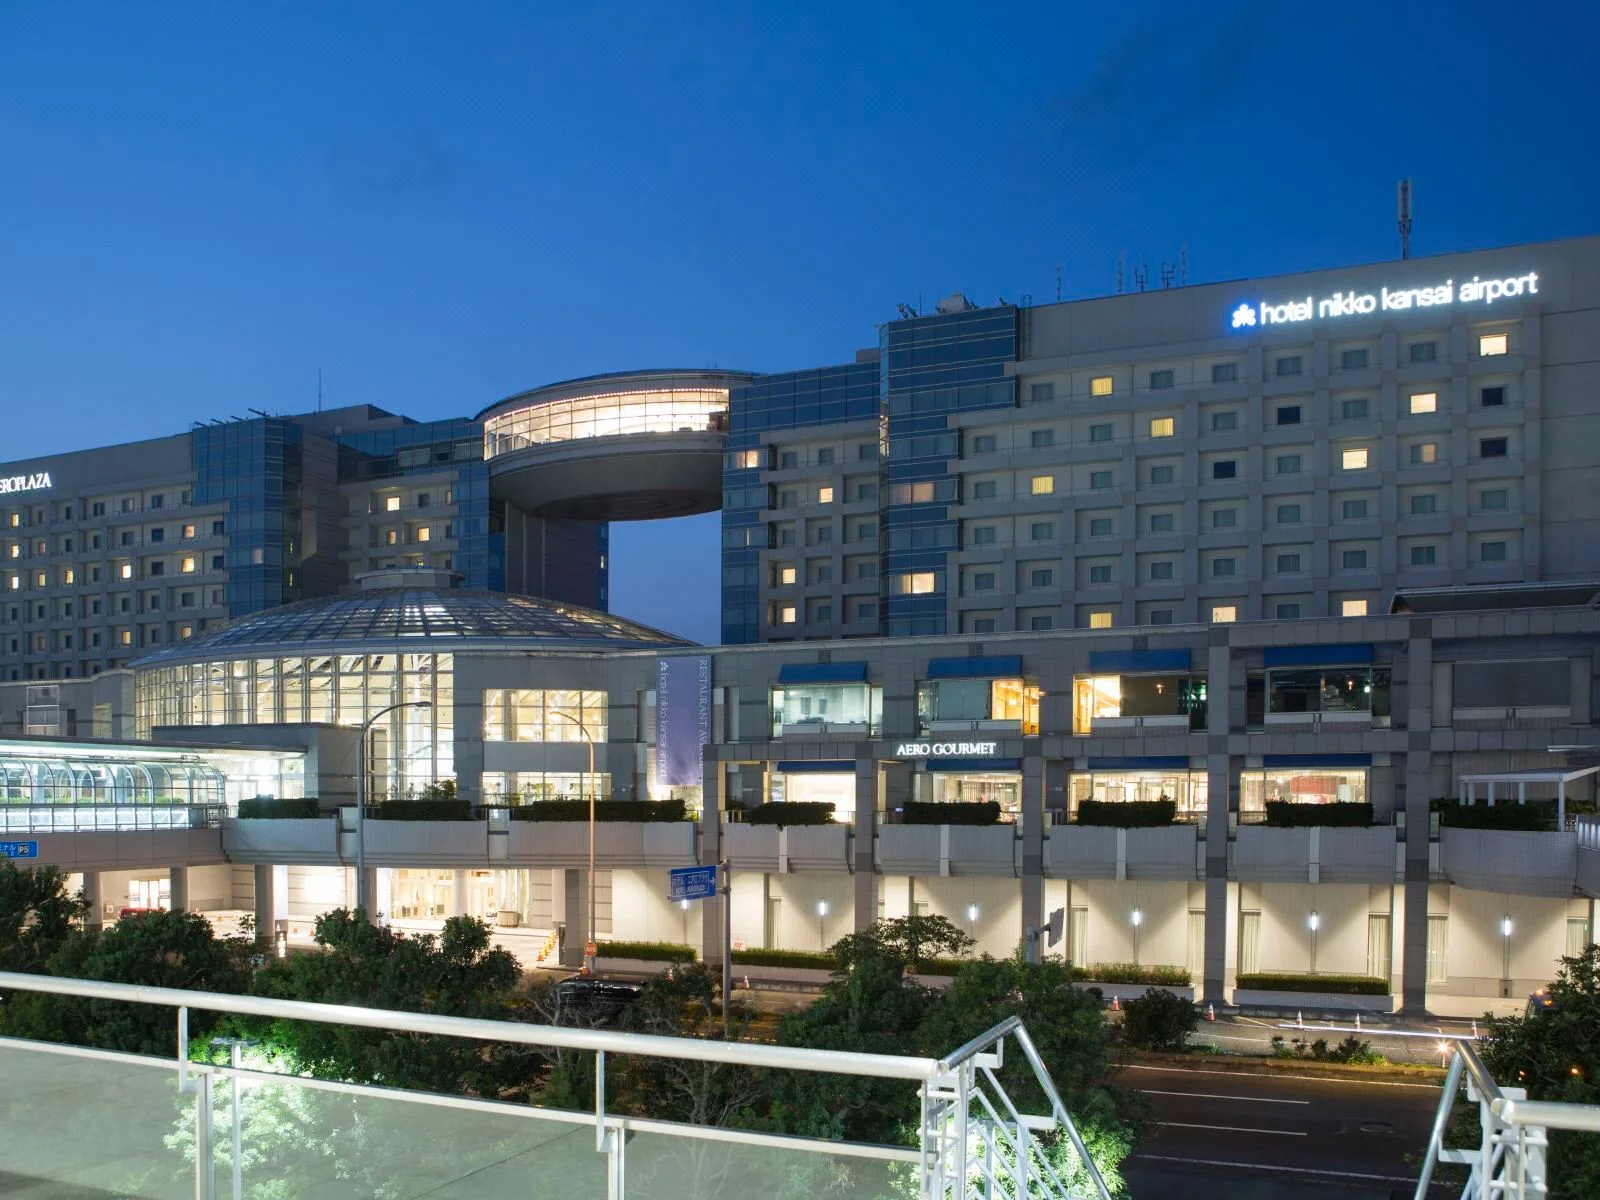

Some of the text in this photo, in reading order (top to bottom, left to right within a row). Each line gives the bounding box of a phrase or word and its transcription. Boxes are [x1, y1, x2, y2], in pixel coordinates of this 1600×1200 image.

[1260, 272, 1538, 325] hotel nikko kansai airport
[699, 659, 708, 726] RESTAURANT
[659, 672, 669, 778] hotel nikko kansai airport
[896, 742, 996, 756] AERO GOURMET
